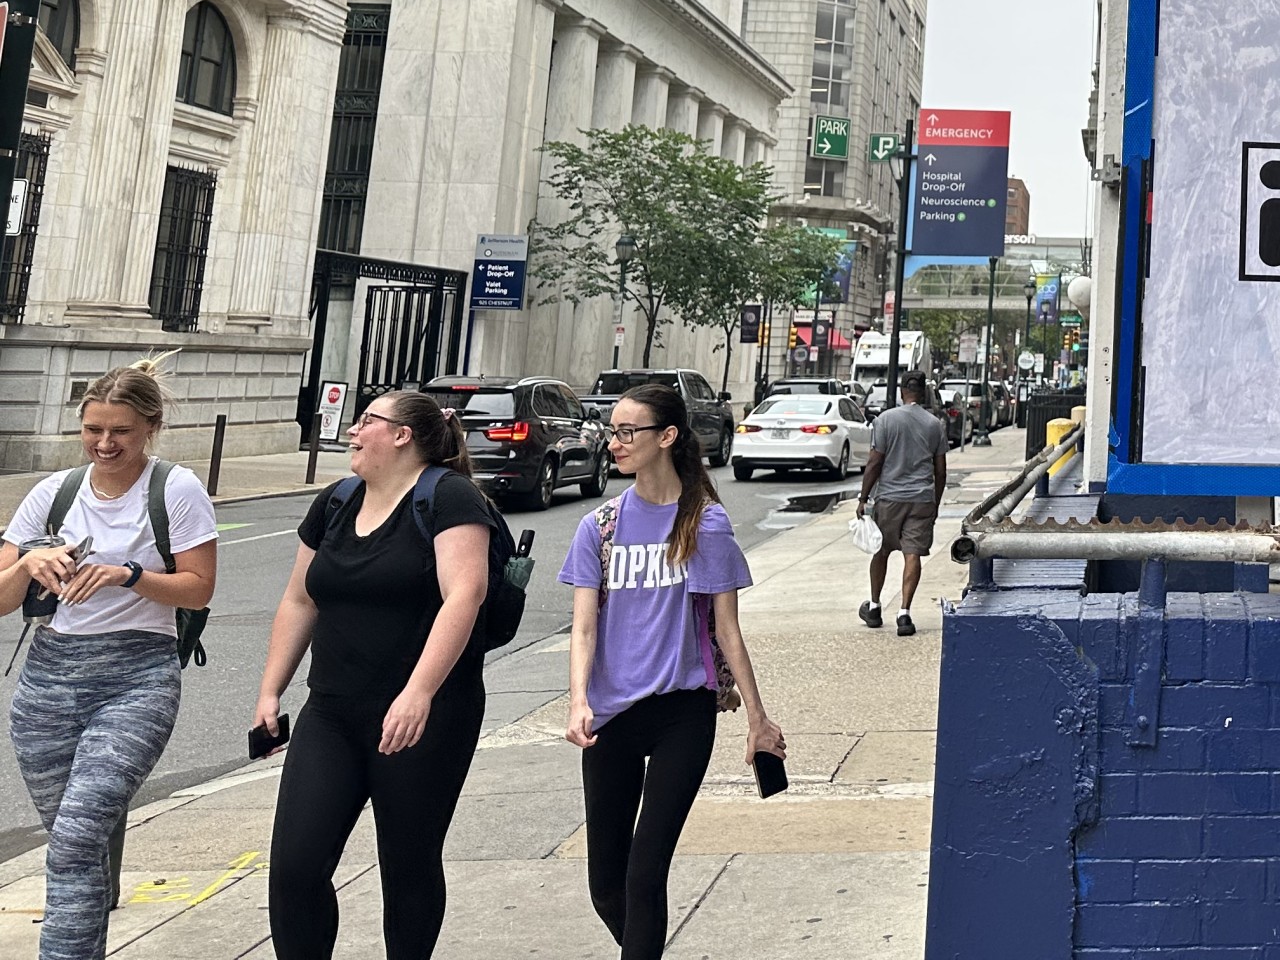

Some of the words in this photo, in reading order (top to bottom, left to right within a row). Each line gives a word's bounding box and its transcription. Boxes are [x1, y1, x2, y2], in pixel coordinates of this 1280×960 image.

[819, 119, 848, 137] PARK
[925, 128, 994, 139] EMERGENCY
[922, 171, 962, 182] Hospital
[921, 182, 966, 193] Drop-Off
[921, 196, 986, 207] Neuroscience
[920, 211, 956, 222] Parking
[485, 287, 508, 295] Parking
